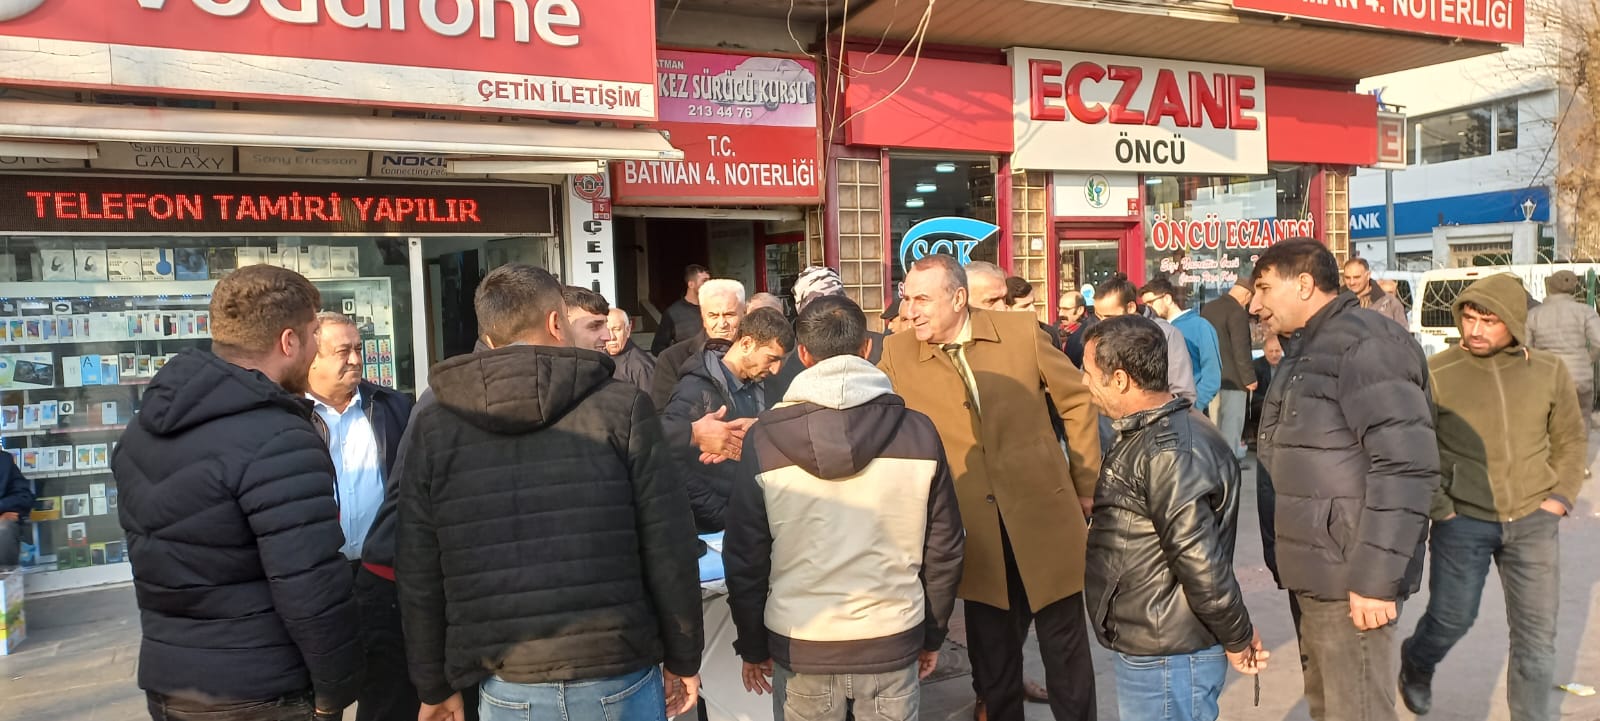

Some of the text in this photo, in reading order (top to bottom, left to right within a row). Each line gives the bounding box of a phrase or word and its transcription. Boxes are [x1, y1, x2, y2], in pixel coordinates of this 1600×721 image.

[477, 78, 641, 110] ÇETİN İLETİŞİM
[692, 68, 756, 102] SÜRÜCÜ
[760, 79, 808, 104] KURSU
[1028, 58, 1258, 130] ECZANE
[688, 105, 752, 118] 213 44 76
[134, 144, 200, 157] Samsung
[252, 153, 357, 165] Sony Ericsson
[707, 136, 736, 156] T.C.
[1115, 131, 1186, 165] ÖNCÜ
[135, 154, 225, 170] GALAXY
[381, 166, 429, 177] Connecting
[625, 159, 814, 186] BATMAN 4. NOTERLİĞİ
[27, 191, 481, 222] TELEFON TAMİRİ YAPILIR
[1152, 213, 1221, 251] ÖNCÜ
